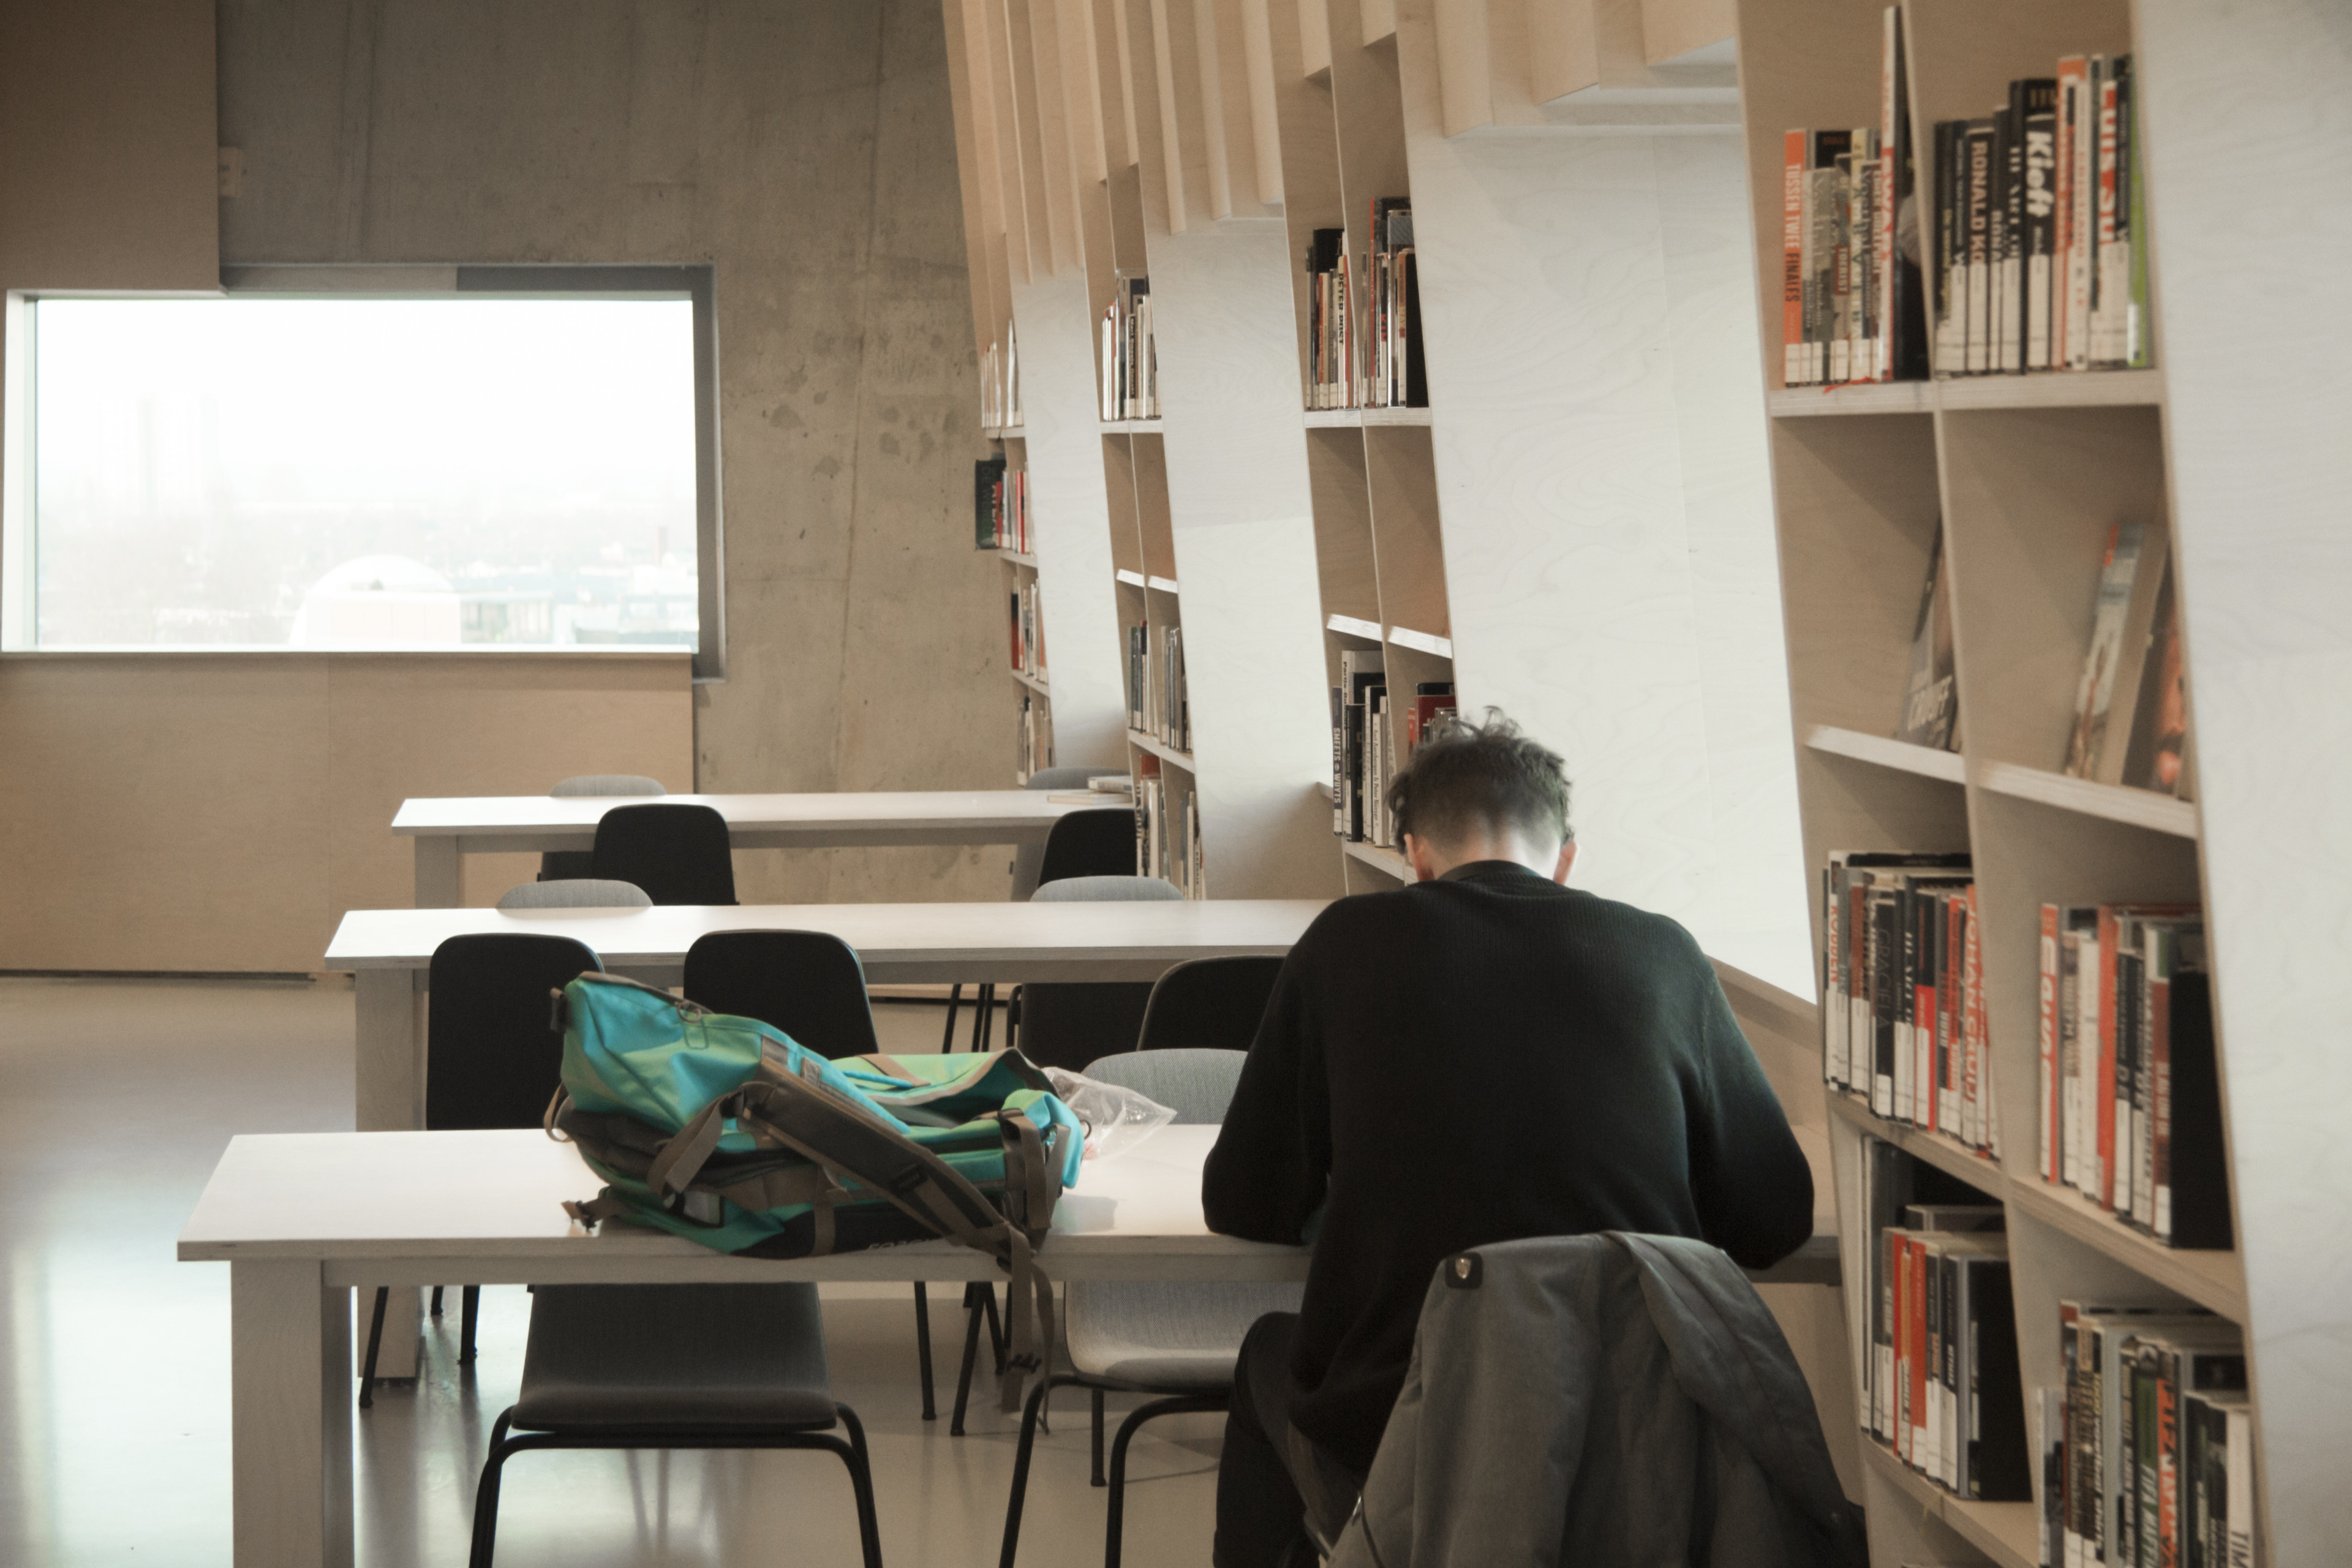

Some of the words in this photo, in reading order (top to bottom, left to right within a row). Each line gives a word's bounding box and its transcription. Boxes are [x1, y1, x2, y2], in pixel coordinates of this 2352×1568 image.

[1785, 163, 1801, 211] TUSSEN
[1970, 141, 1988, 230] RONALD
[2026, 130, 2054, 217] Kieft
[1785, 214, 1801, 248] TWEE
[1785, 252, 1801, 303] FINALES
[1838, 246, 1849, 293] TOERIST
[1966, 907, 1977, 1012] JOHAN
[1964, 1014, 1977, 1104] CRUIJ
